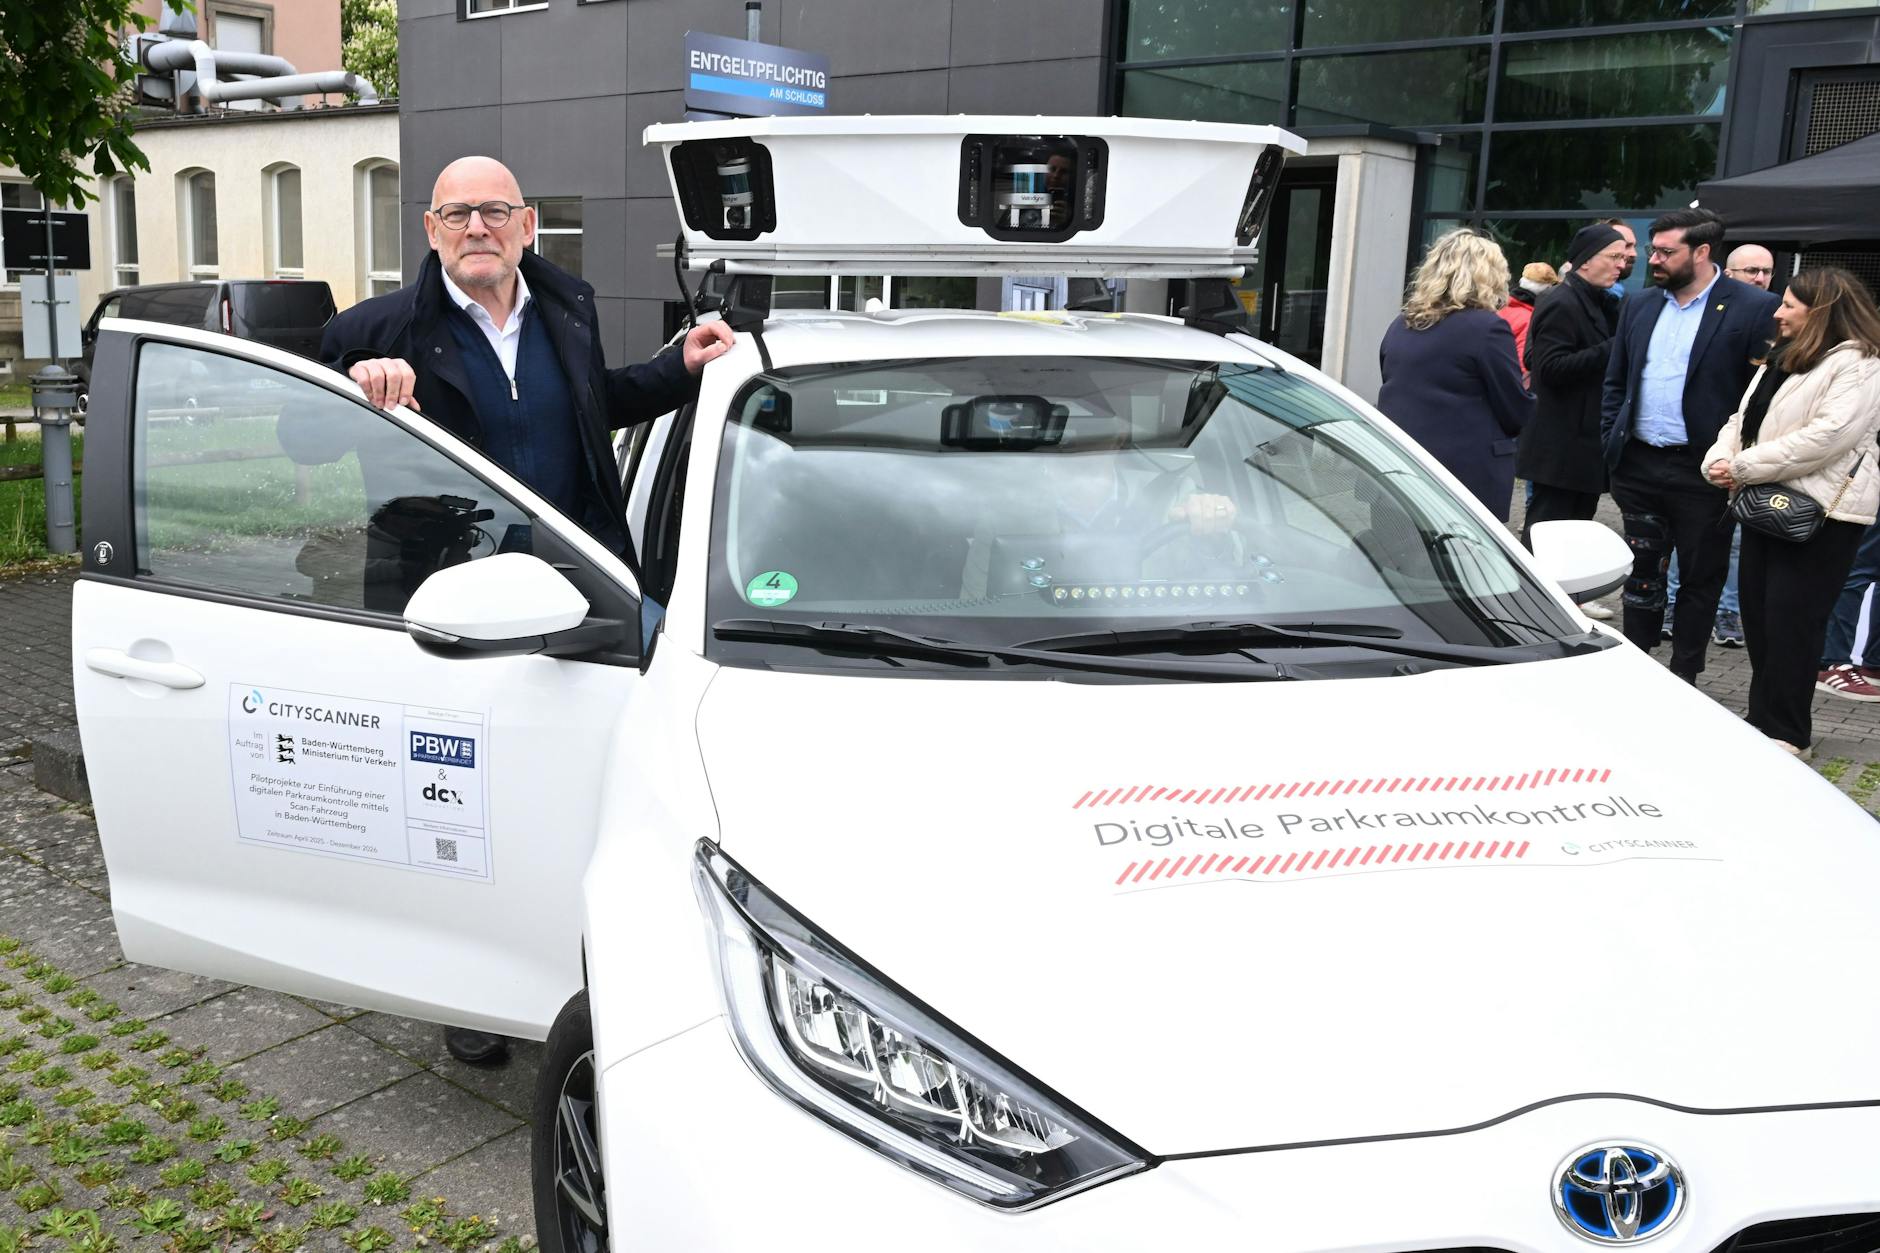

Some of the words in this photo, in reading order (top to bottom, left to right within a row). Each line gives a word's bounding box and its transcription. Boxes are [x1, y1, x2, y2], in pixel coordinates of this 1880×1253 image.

[690, 50, 826, 88] ENTGELTPFLICHTIG
[770, 88, 782, 98] AM
[786, 90, 824, 104] SCHLOSS
[766, 572, 781, 588] 4
[269, 702, 380, 729] CITYSCANNER
[236, 739, 264, 751] Auftrag
[253, 732, 263, 740] Im
[412, 734, 459, 758] PBW
[250, 752, 264, 760] von
[302, 738, 384, 757] Baden-Württemberg
[302, 748, 349, 761] Ministerium
[351, 754, 363, 763] für
[364, 757, 396, 768] Verkehr
[438, 768, 447, 780] &
[250, 774, 301, 788] Pilotprojekte
[318, 784, 362, 798] Einführung
[364, 792, 386, 800] einer
[422, 783, 464, 804] dcx
[250, 786, 283, 796] digitalen
[286, 790, 358, 808] Parkraumkontrolle
[361, 802, 389, 813] mittels
[290, 802, 348, 819] Scan-Fahrzeug
[274, 810, 282, 818] in
[284, 812, 366, 833] Baden-Württemberg
[1094, 816, 1265, 846] Digitale
[1277, 796, 1663, 834] Parkraumkontrolle
[266, 830, 293, 840] Zeitraum
[294, 834, 308, 842] April
[310, 836, 325, 845] 2025
[330, 840, 360, 851] Dezember
[1588, 840, 1699, 853] CITYSCANNER
